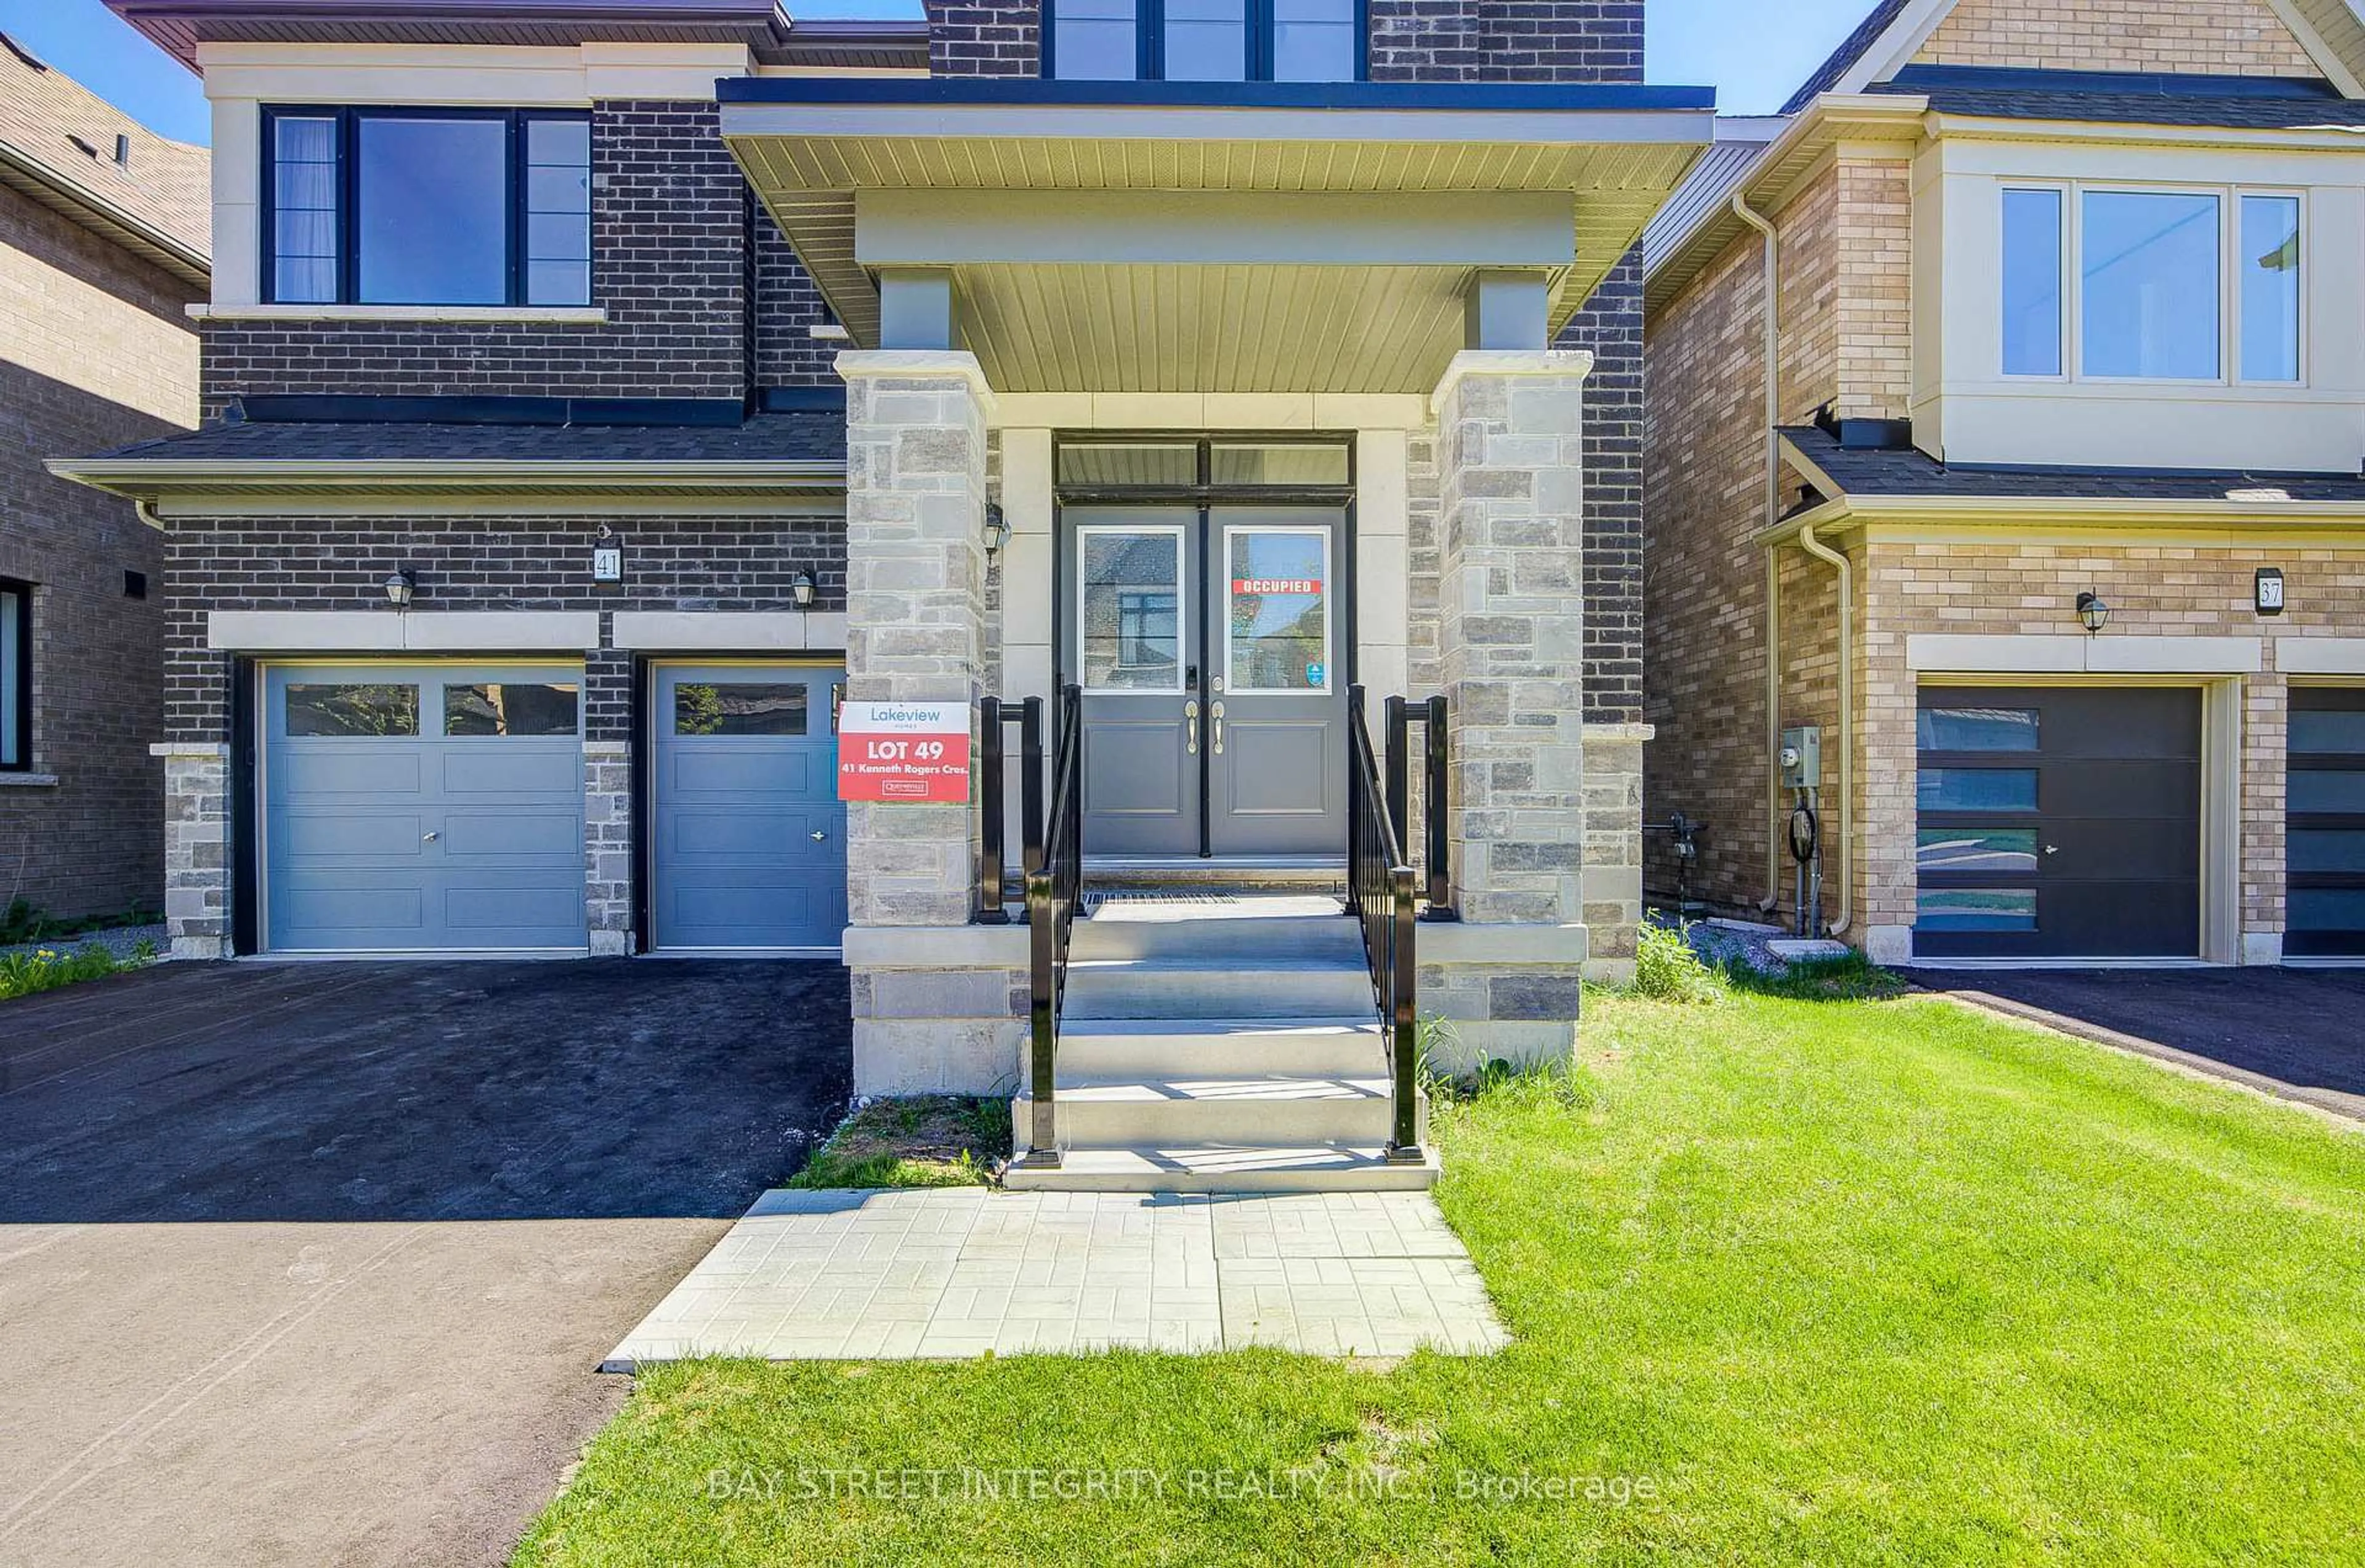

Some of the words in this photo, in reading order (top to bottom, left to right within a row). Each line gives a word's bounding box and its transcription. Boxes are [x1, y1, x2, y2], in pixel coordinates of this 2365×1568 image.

[597, 554, 617, 575] 41
[1243, 580, 1311, 592] OCCUPIED
[2262, 583, 2280, 602] 37
[871, 708, 940, 721] Lakeview
[868, 741, 908, 759] LOT
[915, 741, 944, 759] 49
[841, 764, 855, 774] 41
[859, 763, 902, 774] Kenneth
[904, 764, 940, 776] Rogers
[942, 765, 969, 774] Cres.
